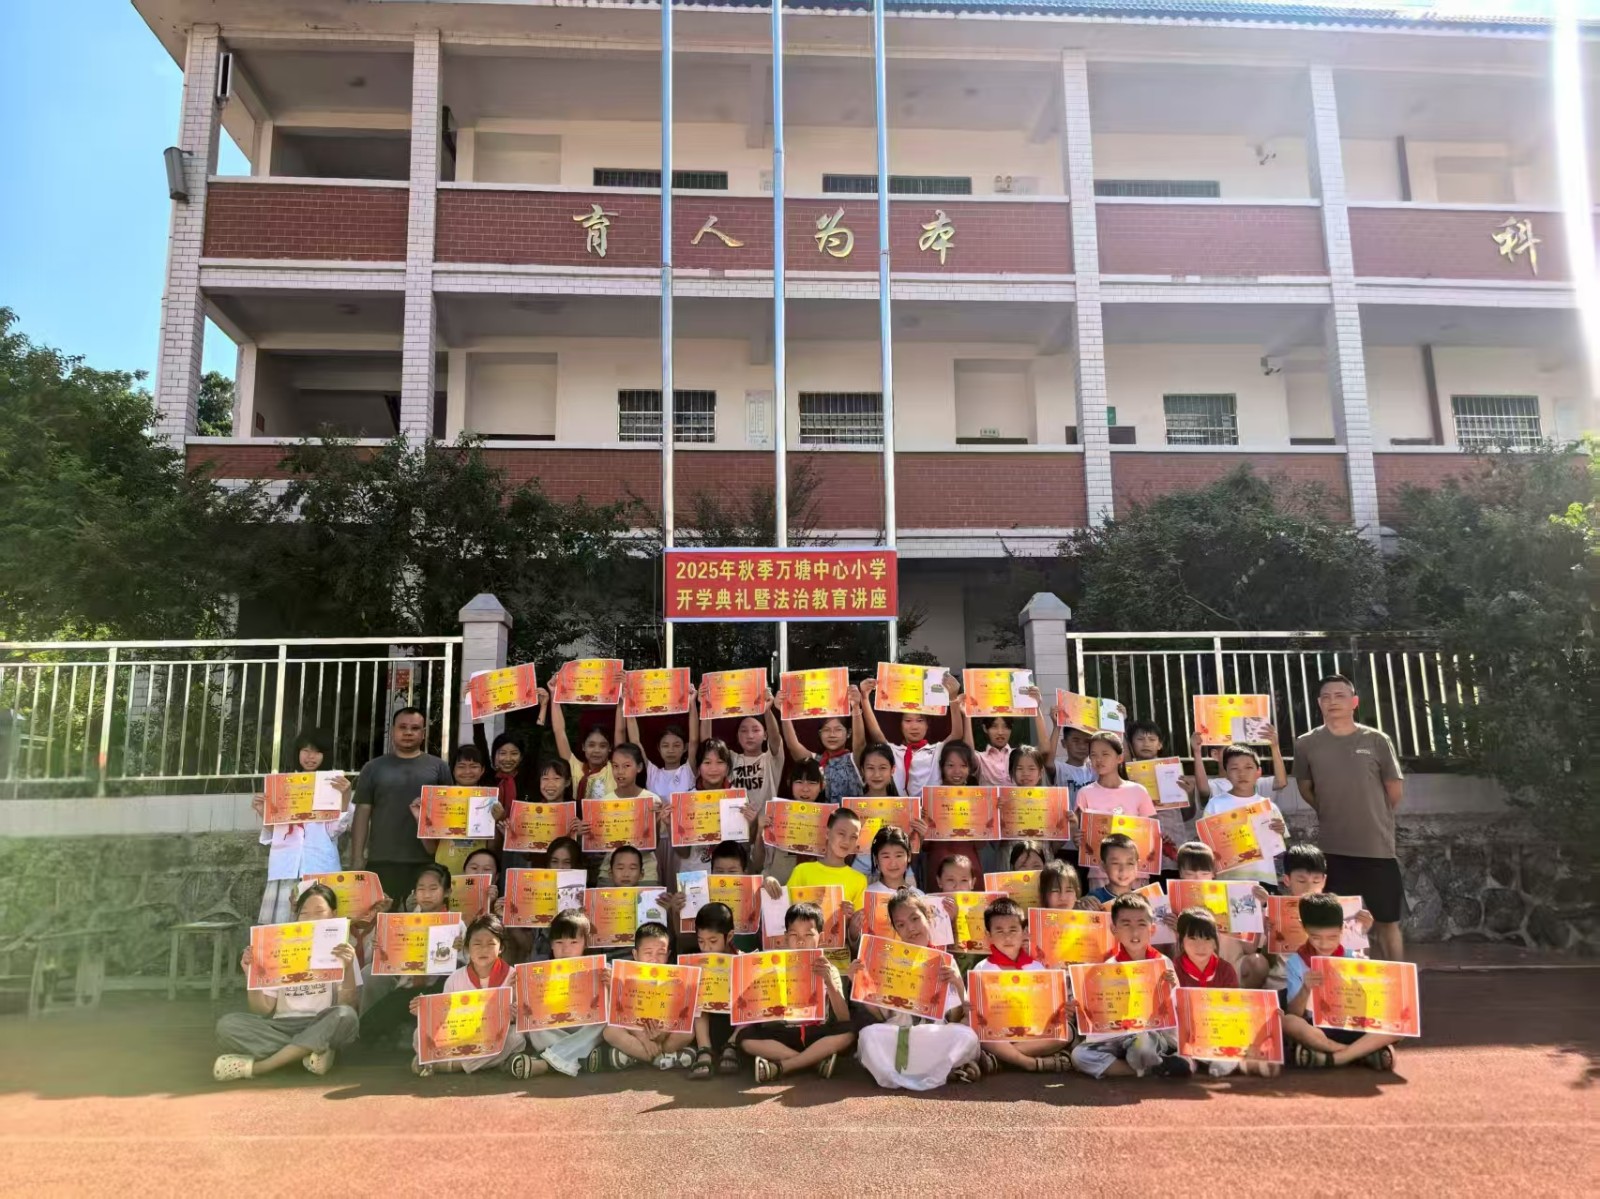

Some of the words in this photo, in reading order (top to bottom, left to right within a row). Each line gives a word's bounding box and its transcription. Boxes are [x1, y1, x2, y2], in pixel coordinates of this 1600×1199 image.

[572, 203, 956, 265] 育人为本
[1491, 216, 1541, 276] 科
[675, 558, 887, 581] 2025年秋季万塘中心小学
[676, 588, 888, 610] 开学典礼暨法治教育讲座
